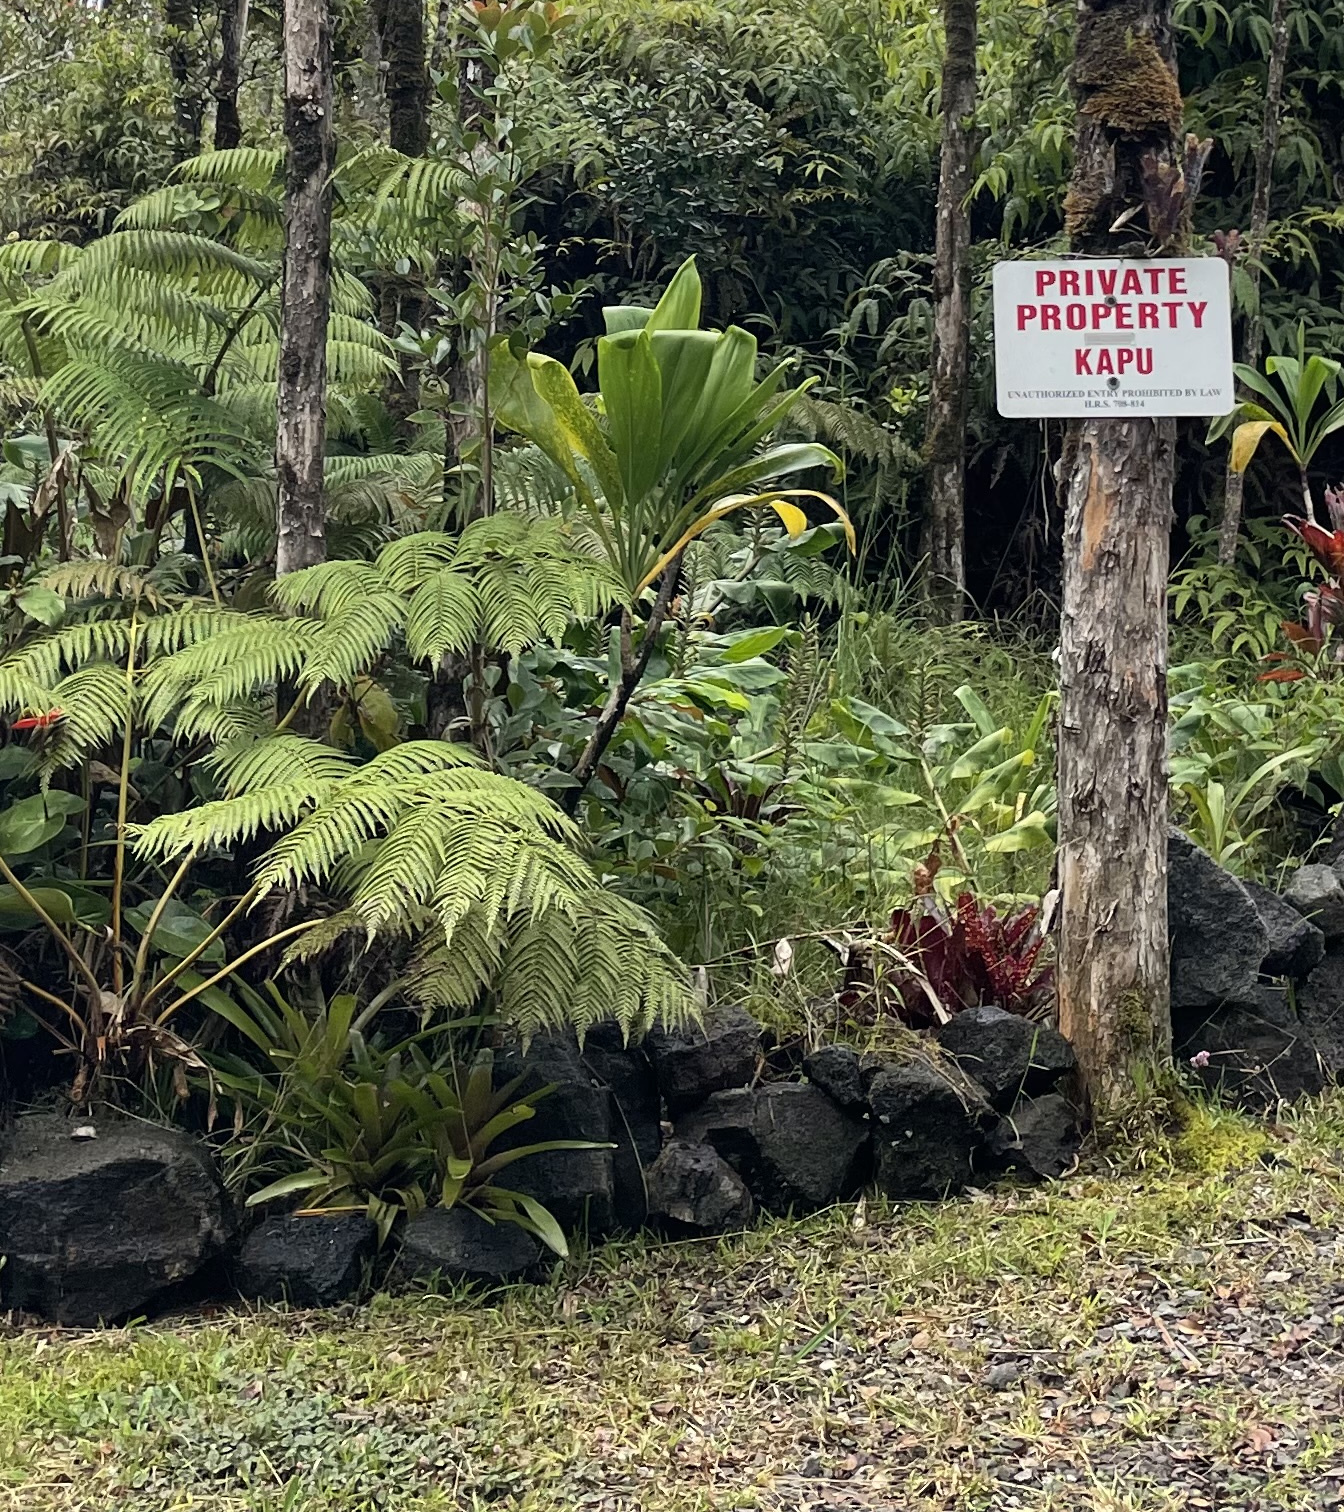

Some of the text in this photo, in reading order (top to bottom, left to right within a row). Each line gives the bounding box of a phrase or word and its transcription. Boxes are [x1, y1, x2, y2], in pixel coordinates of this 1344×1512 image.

[1036, 268, 1187, 296] PRIVATE
[1017, 301, 1207, 330] PROPERTY
[1075, 347, 1153, 375] KAPU
[1008, 388, 1221, 399] UNAUTHORIZED ENTRY PROHIBITED BY LAW
